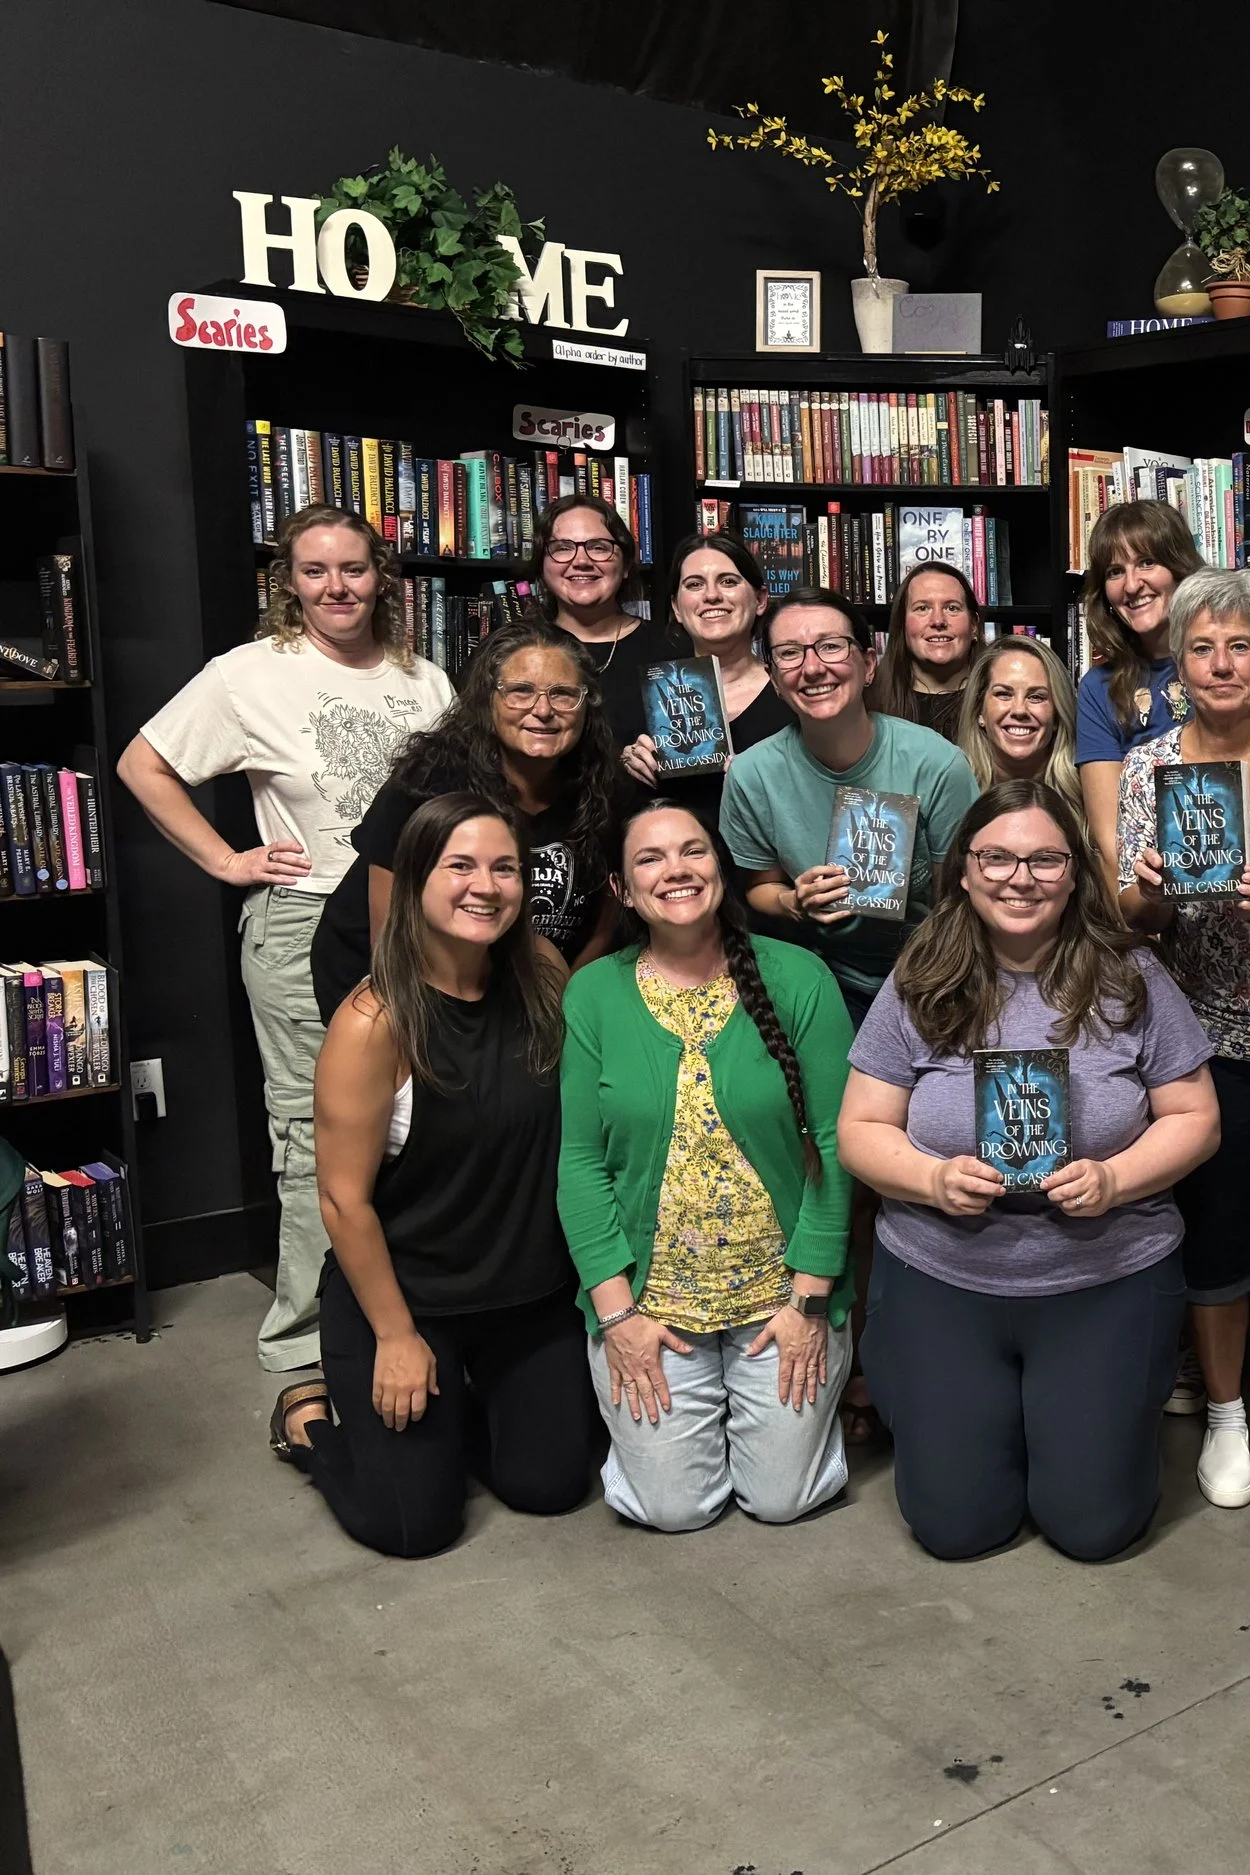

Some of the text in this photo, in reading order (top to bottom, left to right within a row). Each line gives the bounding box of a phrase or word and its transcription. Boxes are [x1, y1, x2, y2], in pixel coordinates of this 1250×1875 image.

[176, 298, 273, 350] Scaries
[1130, 318, 1192, 335] HOME
[555, 343, 645, 368] Alpha order by author
[519, 411, 605, 442] Scaries
[967, 415, 978, 444] SUSPECTS
[247, 440, 259, 497] NO EXIT
[331, 446, 342, 500] DAVID BALDACCI
[349, 450, 360, 504] DAVID BALDACCI
[368, 453, 379, 507] DAVID BALDACCI
[1157, 470, 1166, 501] WHEELS
[384, 453, 397, 542] DAVID BALDACCI MERCY
[520, 483, 532, 540] SANDRA BROWN
[903, 511, 943, 527] ONE
[743, 527, 798, 539] SLAUGHTER
[927, 529, 949, 543] BY
[915, 546, 955, 561] ONE
[767, 569, 800, 581] IS WHY
[769, 583, 790, 593] LIED
[658, 695, 706, 717] VEINS
[670, 716, 702, 729] OF THE
[652, 727, 724, 749] DROWNING
[657, 752, 728, 772] KALIE CASSIDY
[1184, 793, 1215, 805] IN THE
[67, 794, 80, 867] VEILED KINGDOM
[1172, 808, 1227, 831] VEINS
[846, 828, 896, 852] VEINS
[1183, 834, 1220, 847] OF THE
[852, 853, 888, 866] OF THE
[1160, 848, 1244, 869] DROWNING
[531, 870, 564, 885] IJA
[1164, 881, 1195, 896] KALIE
[54, 992, 63, 1017] STORM
[67, 1046, 76, 1073] WEXLER
[92, 1044, 100, 1071] WEXLER
[1007, 1082, 1040, 1094] IN THE
[993, 1098, 1051, 1121] VEINS
[1005, 1124, 1044, 1137] OF THE
[979, 1139, 1068, 1160] DROWNING
[34, 1247, 46, 1284] BREAKER
[42, 1247, 54, 1280] HEAVEN
